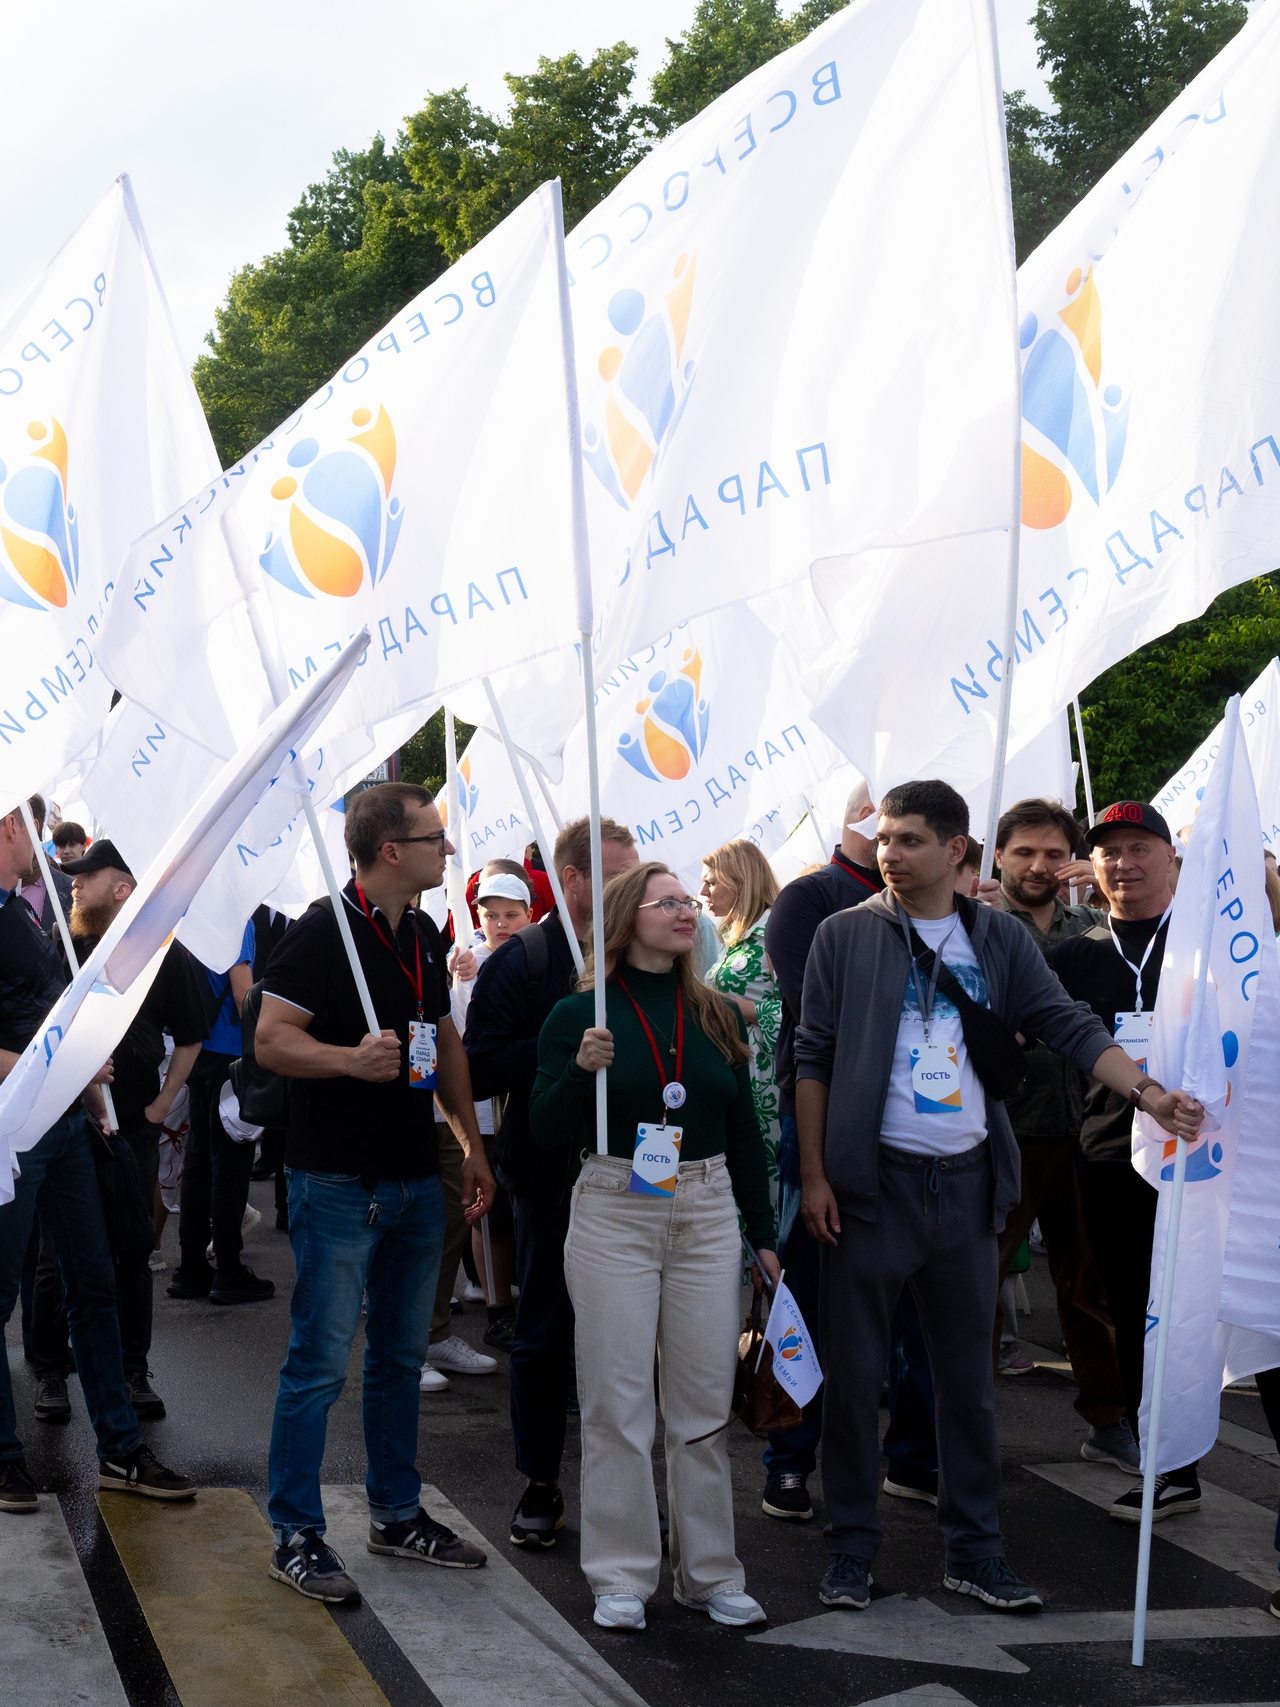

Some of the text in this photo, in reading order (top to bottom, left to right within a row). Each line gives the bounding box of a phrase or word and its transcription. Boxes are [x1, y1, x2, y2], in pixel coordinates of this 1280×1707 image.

[1103, 803, 1143, 822] 40
[920, 1071, 951, 1081] ГОСТЬ
[642, 1153, 671, 1164] ГОСТЬ
[774, 1360, 798, 1388] СЕМЬИ
